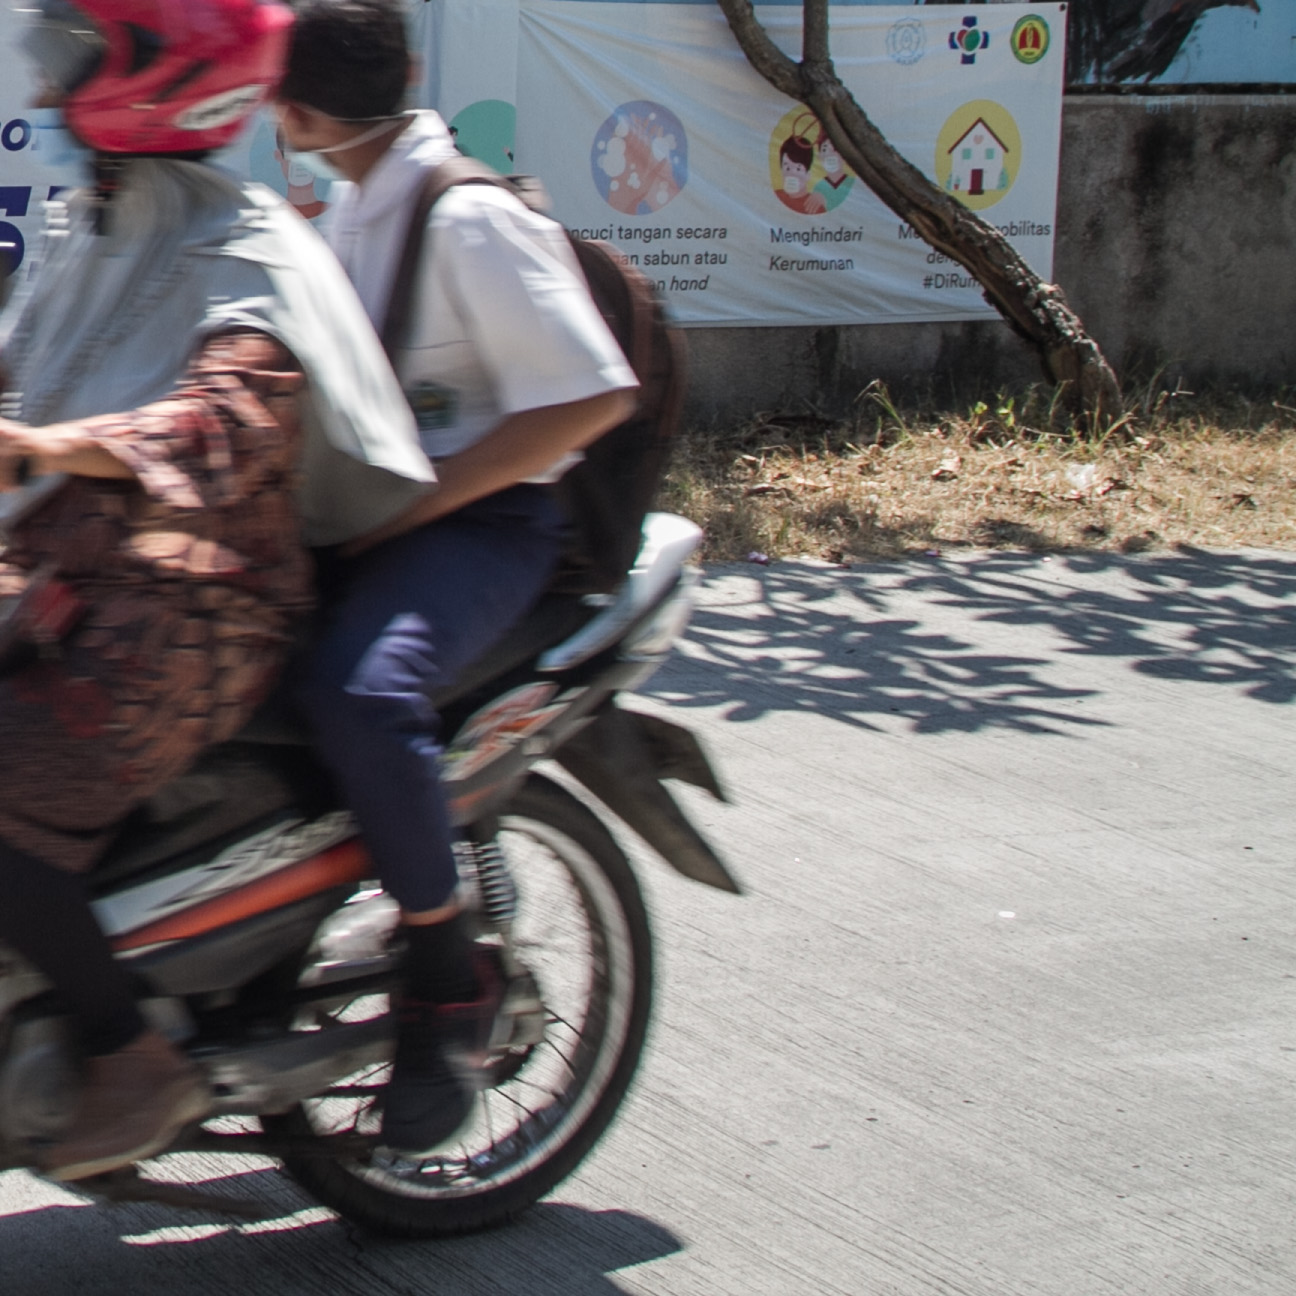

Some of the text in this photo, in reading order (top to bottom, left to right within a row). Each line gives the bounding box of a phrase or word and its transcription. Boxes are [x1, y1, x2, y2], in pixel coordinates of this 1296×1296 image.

[617, 225, 671, 244] tangan
[676, 226, 728, 240] secara
[770, 226, 864, 247] Menghindari
[996, 221, 1051, 237] obilitas
[643, 249, 690, 266] sabun
[694, 251, 728, 265] atau
[769, 255, 855, 272] Kerumunan
[669, 275, 711, 292] hand
